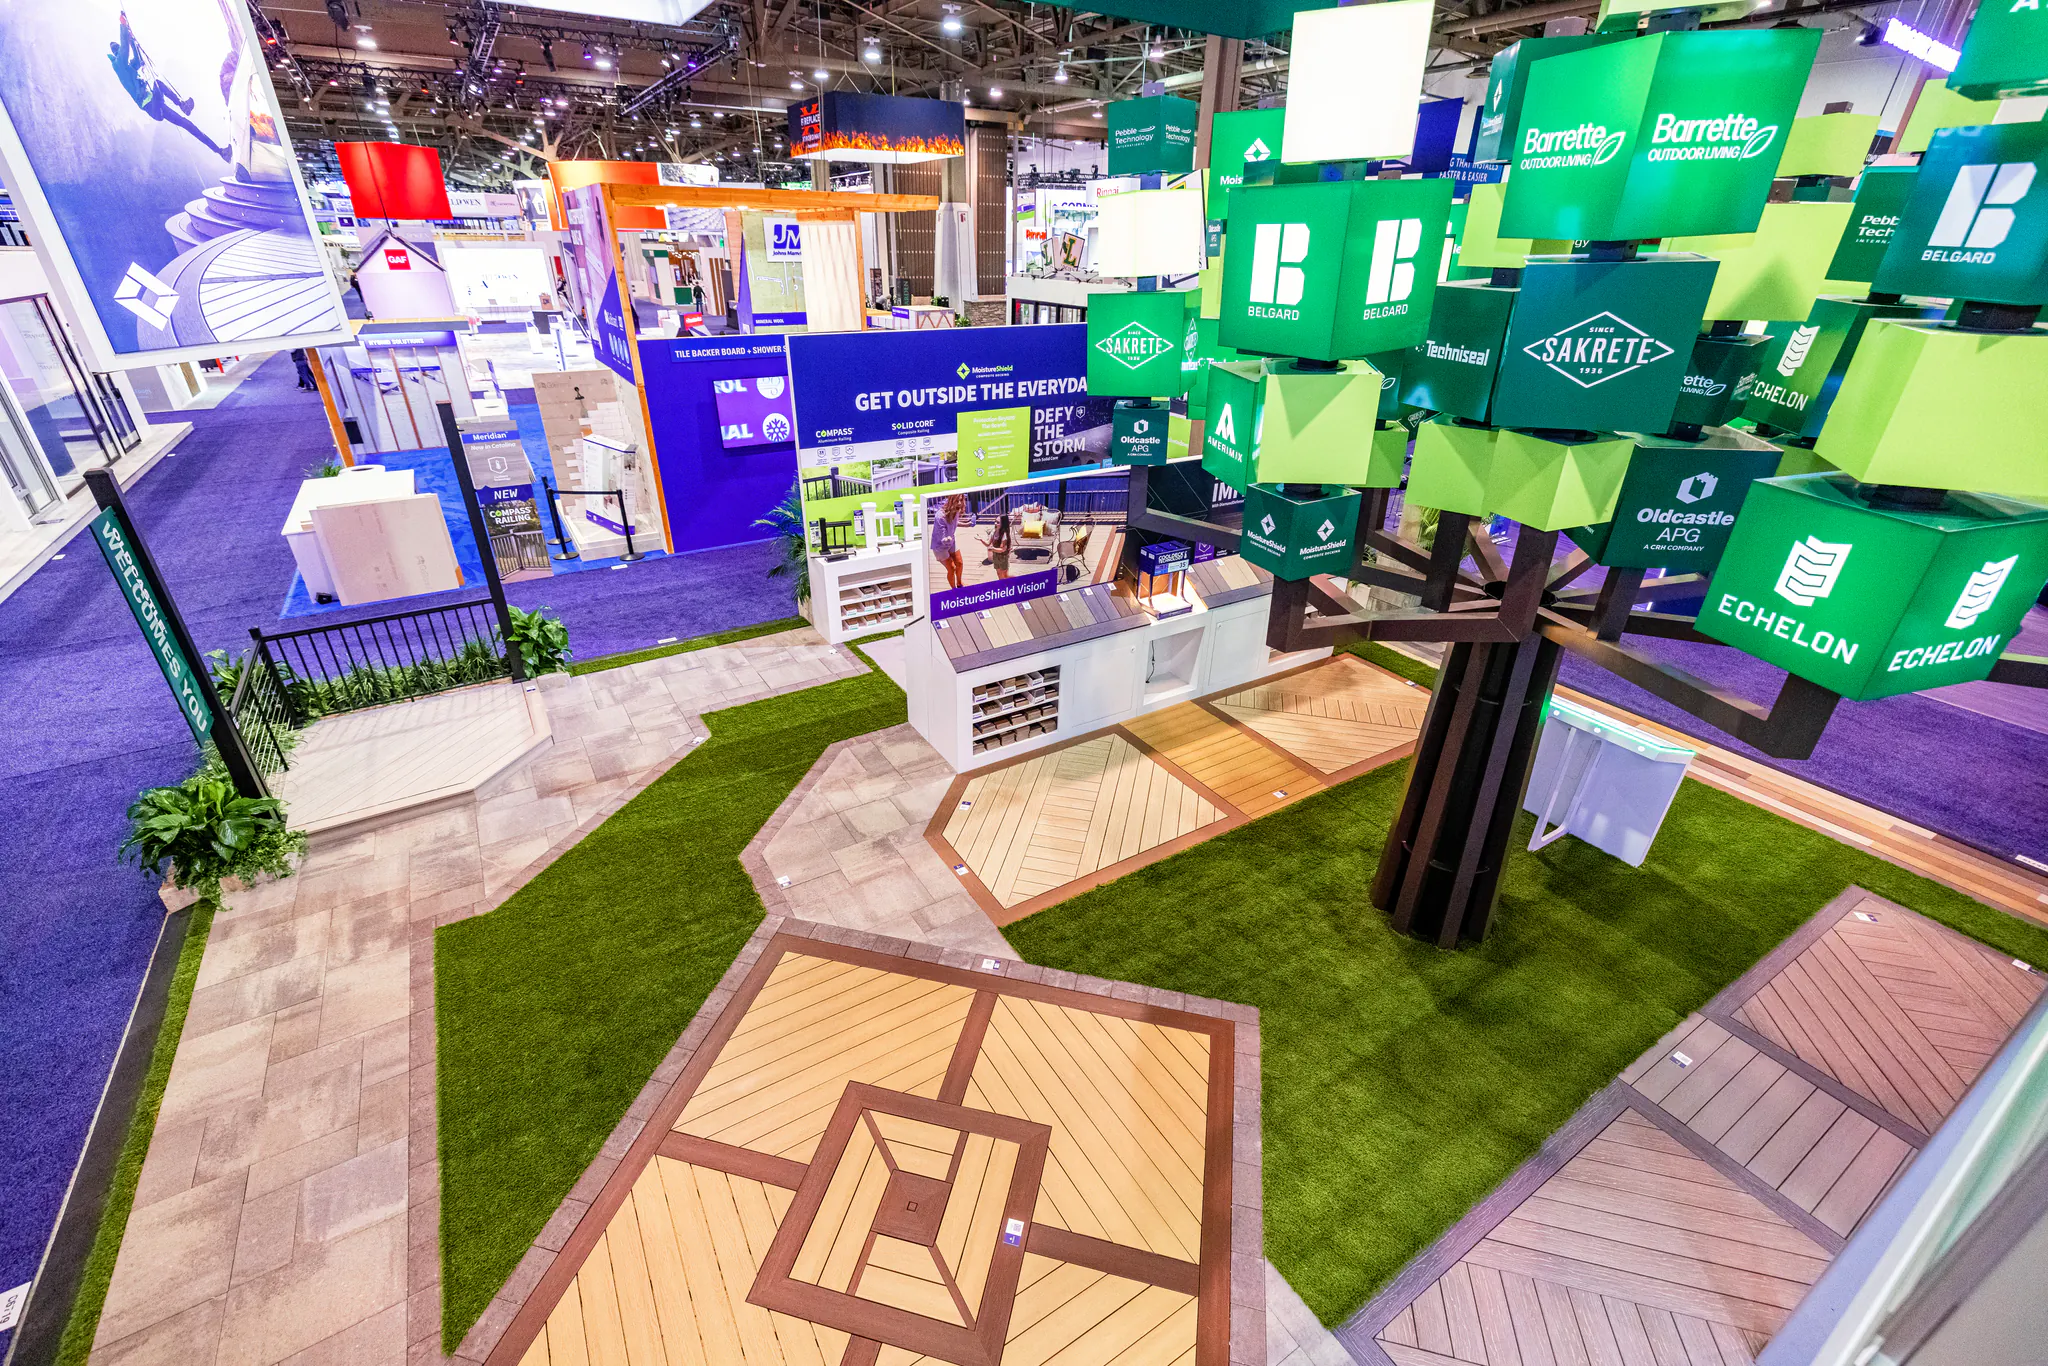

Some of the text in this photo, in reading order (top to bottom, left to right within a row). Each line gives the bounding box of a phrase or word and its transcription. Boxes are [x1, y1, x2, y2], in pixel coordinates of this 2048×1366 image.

[1115, 128, 1137, 137] Pebble
[1165, 124, 1181, 133] Pebble
[1652, 113, 1758, 144] Barrette
[1115, 133, 1154, 144] Technology
[1165, 132, 1191, 143] Technology
[1523, 122, 1606, 154] Barrette
[1520, 153, 1592, 170] OUTDOOR LIVING
[1648, 145, 1740, 162] OUTDOOR LIVING
[1220, 174, 1243, 185] Mois
[1461, 171, 1466, 180] &
[1467, 172, 1488, 183] EASIER
[387, 256, 407, 264] GAF
[1921, 250, 1996, 265] BELGARD
[1247, 306, 1300, 321] BELGARD
[1363, 304, 1409, 320] BELGARD
[675, 350, 690, 359] TILE
[691, 348, 720, 357] BACKER
[721, 347, 746, 356] BOARD
[752, 345, 781, 354] SHOWER
[1106, 337, 1163, 354] SAKRETE
[1426, 339, 1490, 366] Techniseal
[1542, 337, 1655, 364] SAKRETE
[972, 365, 1013, 374] MoistureShield
[1683, 375, 1714, 388] ette
[855, 376, 1088, 412] GET OUTSIDE THE EVERYDA
[1750, 380, 1809, 412] CHELON
[1034, 406, 1074, 424] DEFY
[815, 428, 853, 438] COMPASS
[891, 419, 934, 431] SOLID CORE
[1034, 423, 1064, 440] THE
[472, 432, 507, 440] Meridian
[1120, 436, 1161, 444] Oldcastle
[1033, 437, 1086, 457] STORM
[1131, 445, 1149, 453] APG
[1207, 435, 1243, 463] AMERIMIX
[494, 488, 518, 499] NEW
[489, 507, 531, 518] COMPASS
[495, 514, 531, 524] RAILING
[1637, 508, 1735, 526] Oldcastle
[1247, 529, 1287, 553] MoistureShield
[1656, 527, 1701, 543] APG
[1299, 539, 1347, 555] MoistureShield
[940, 586, 1015, 611] MoistureShield
[101, 520, 208, 732] WELCOMES YOU
[1718, 593, 1859, 665] ECHELON
[1887, 634, 2000, 672] ECHELON
